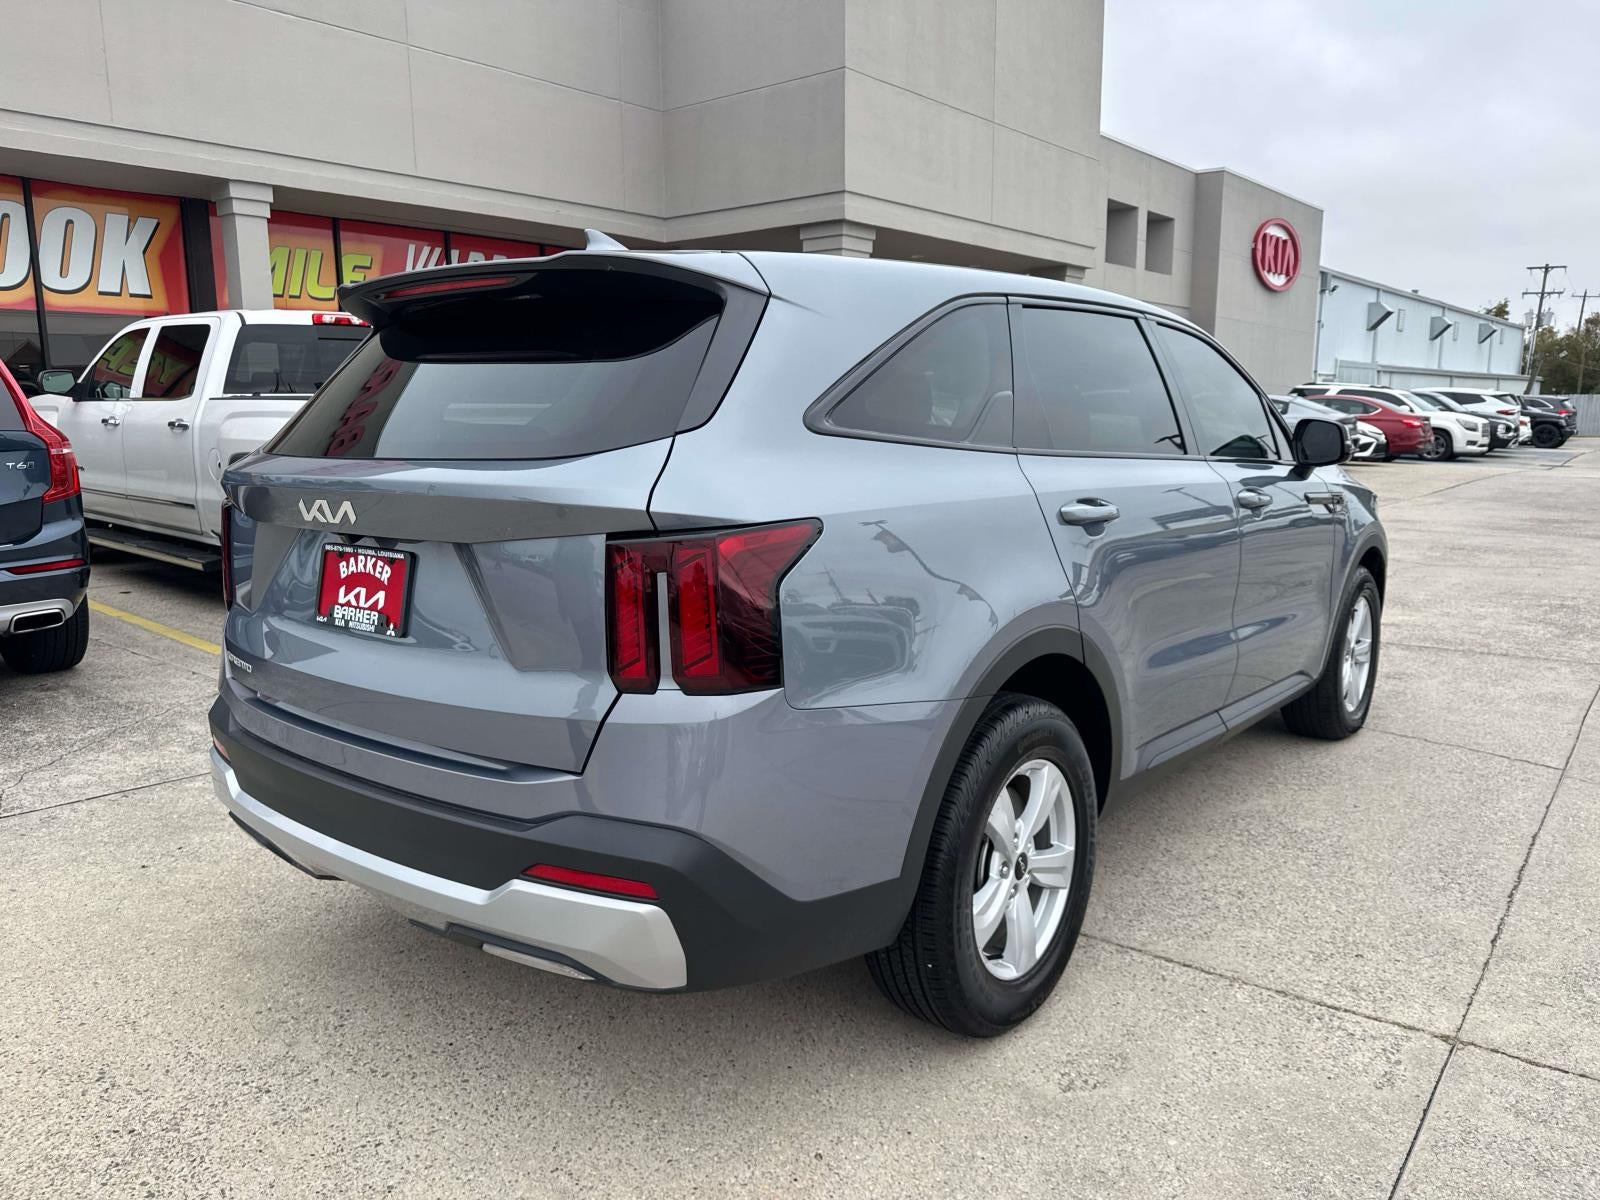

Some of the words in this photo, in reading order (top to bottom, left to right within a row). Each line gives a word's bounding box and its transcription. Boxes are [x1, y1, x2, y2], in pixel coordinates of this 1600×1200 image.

[1264, 232, 1294, 277] KIA
[298, 498, 357, 526] KIA
[339, 555, 392, 586] BARKER
[338, 585, 385, 610] KIA
[333, 605, 378, 625] BARKER
[334, 619, 345, 627] KIA
